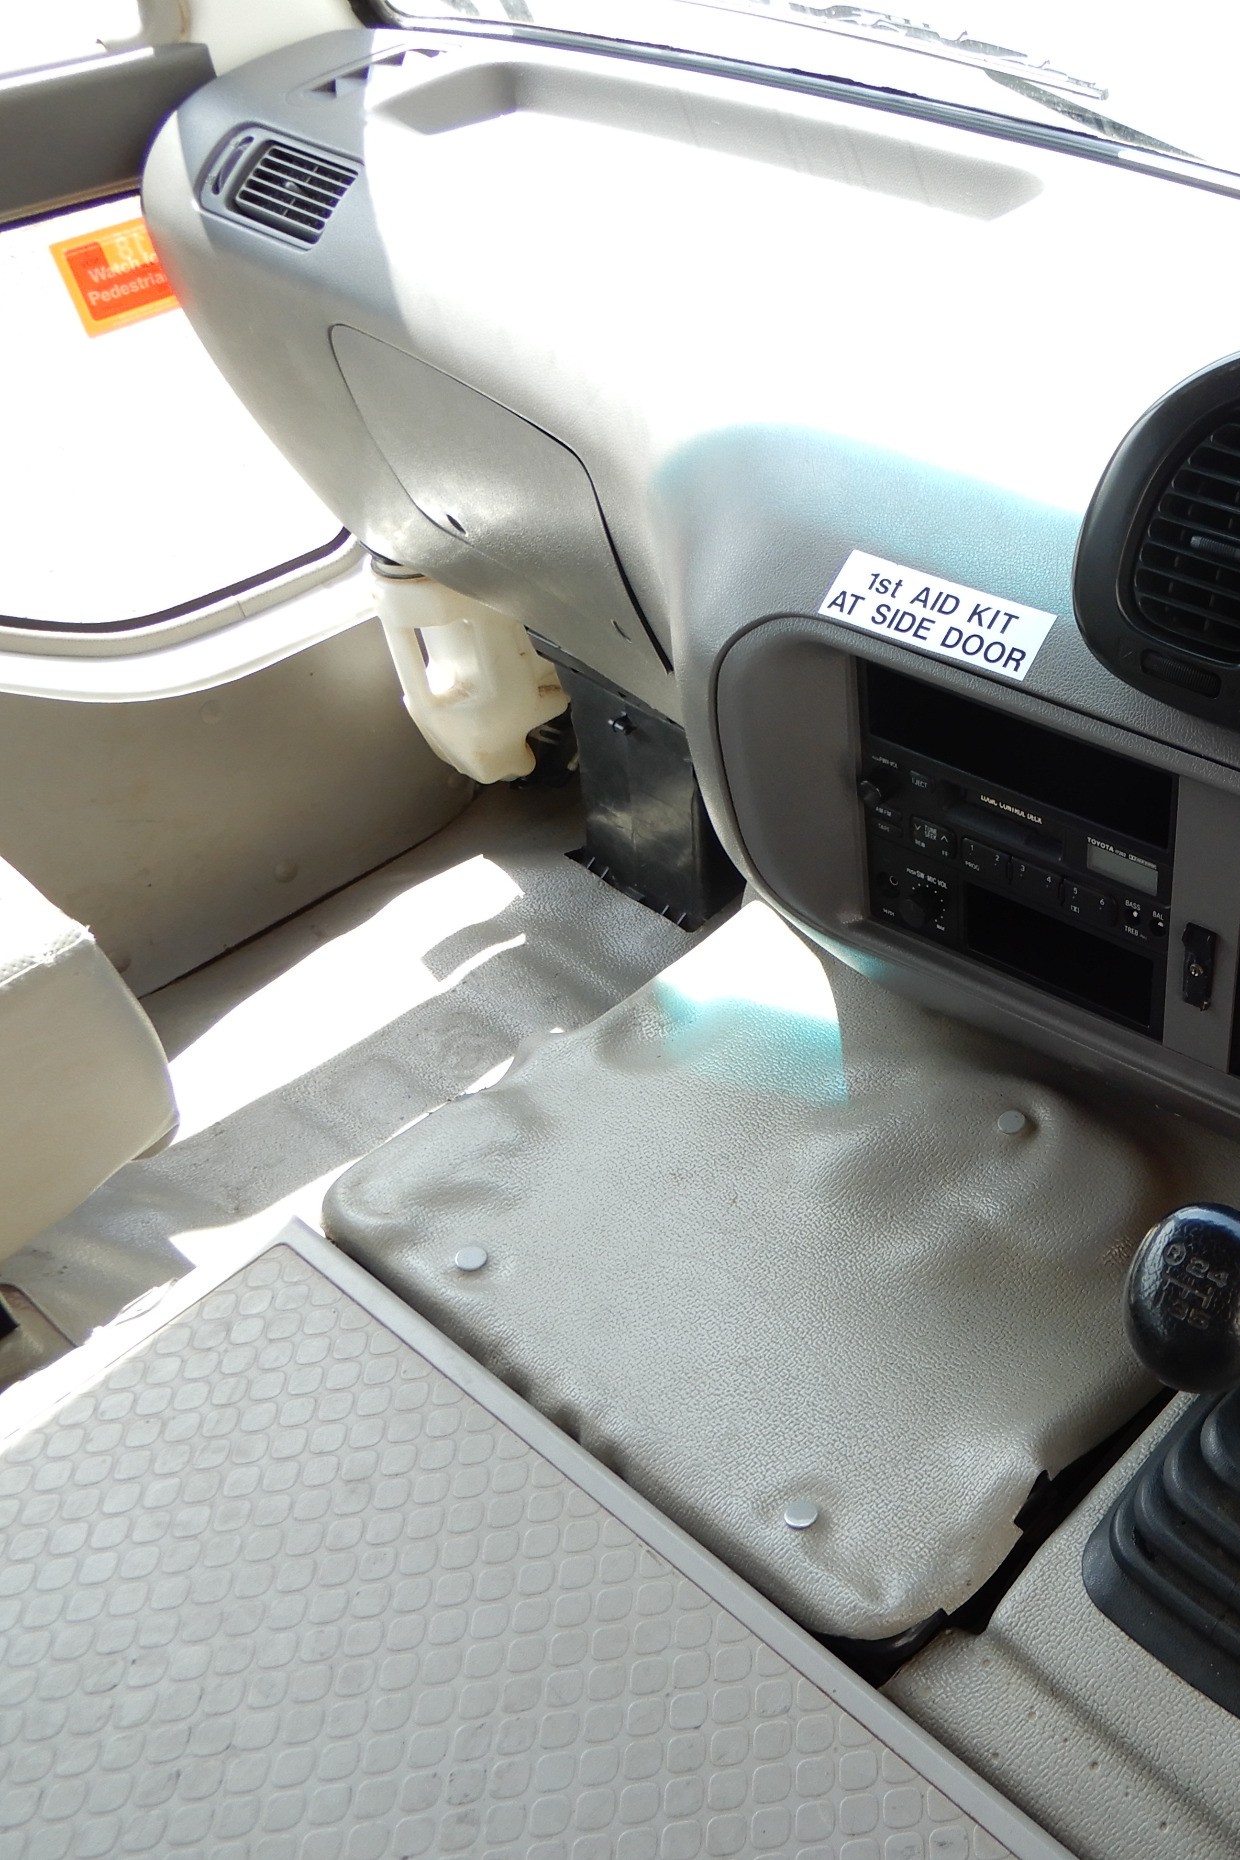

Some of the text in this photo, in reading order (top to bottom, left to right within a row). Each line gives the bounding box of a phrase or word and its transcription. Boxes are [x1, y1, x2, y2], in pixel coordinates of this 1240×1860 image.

[87, 257, 141, 284] Watch
[86, 272, 168, 306] Pedestria
[868, 572, 1019, 634] 1st AID KIT
[827, 590, 1027, 672] AT SIDE DOOR
[1087, 836, 1115, 853] TOYOTA
[994, 854, 1000, 862] 2
[1020, 864, 1026, 872] 3
[1099, 898, 1105, 906] 6
[1125, 899, 1141, 911] BASS
[1152, 910, 1164, 921] BAL
[1124, 925, 1139, 937] TREB
